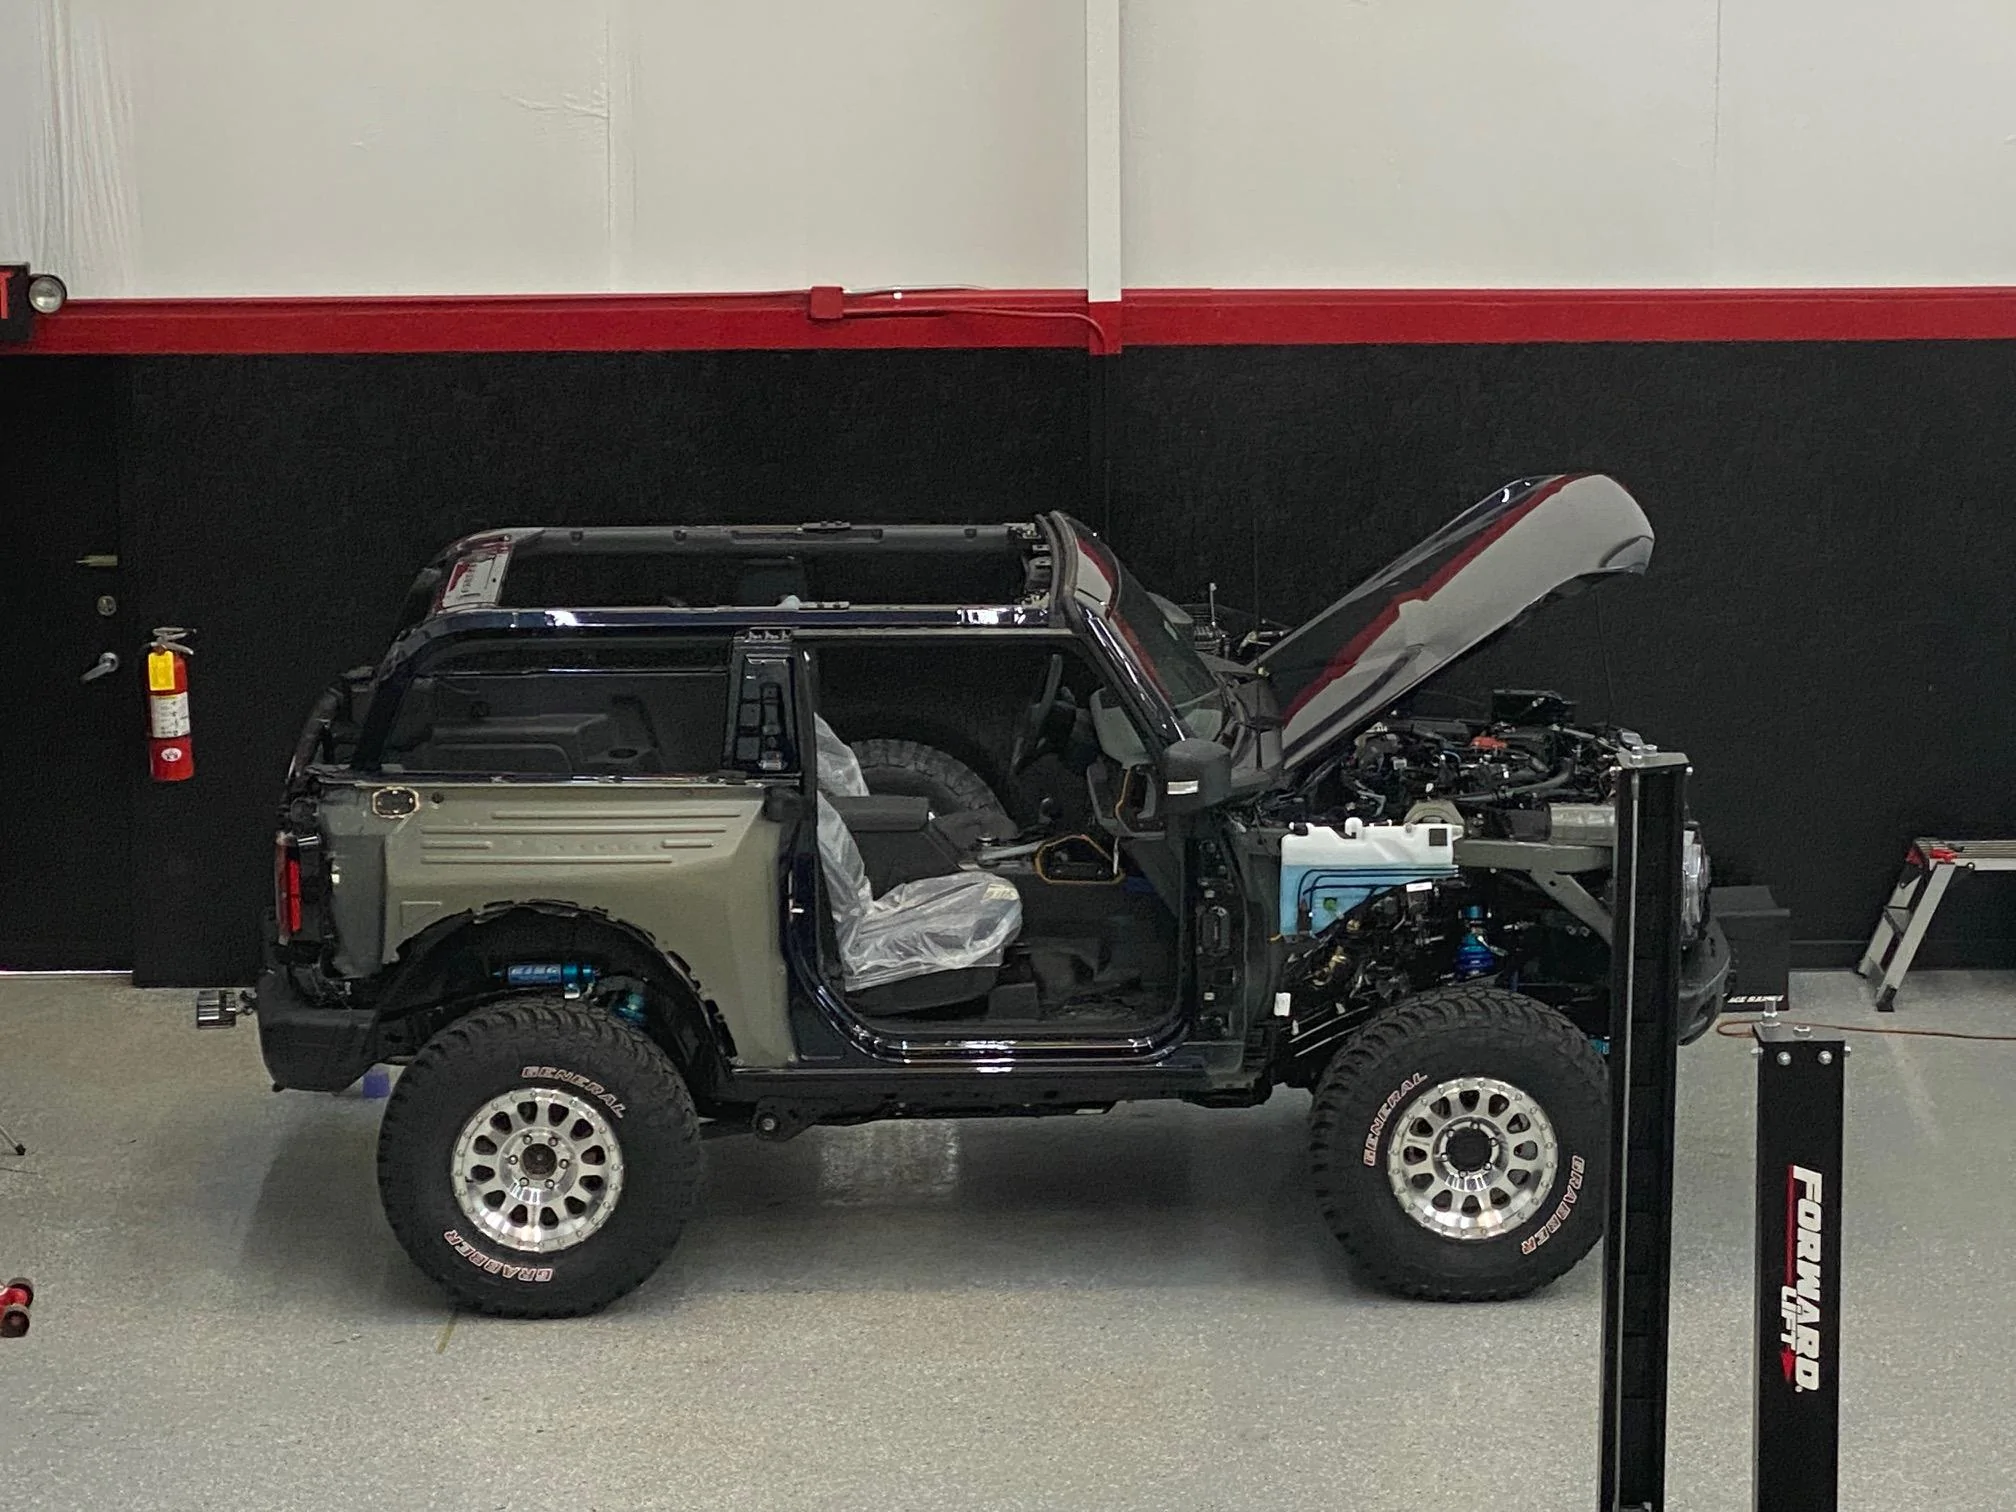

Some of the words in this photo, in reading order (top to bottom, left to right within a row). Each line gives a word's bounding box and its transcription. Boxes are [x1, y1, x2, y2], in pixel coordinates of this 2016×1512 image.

[522, 1066, 626, 1119] GENERAL
[1363, 1072, 1428, 1166] GENERAL
[1521, 1155, 1585, 1255] GRABBER
[443, 1230, 553, 1282] GRABBER
